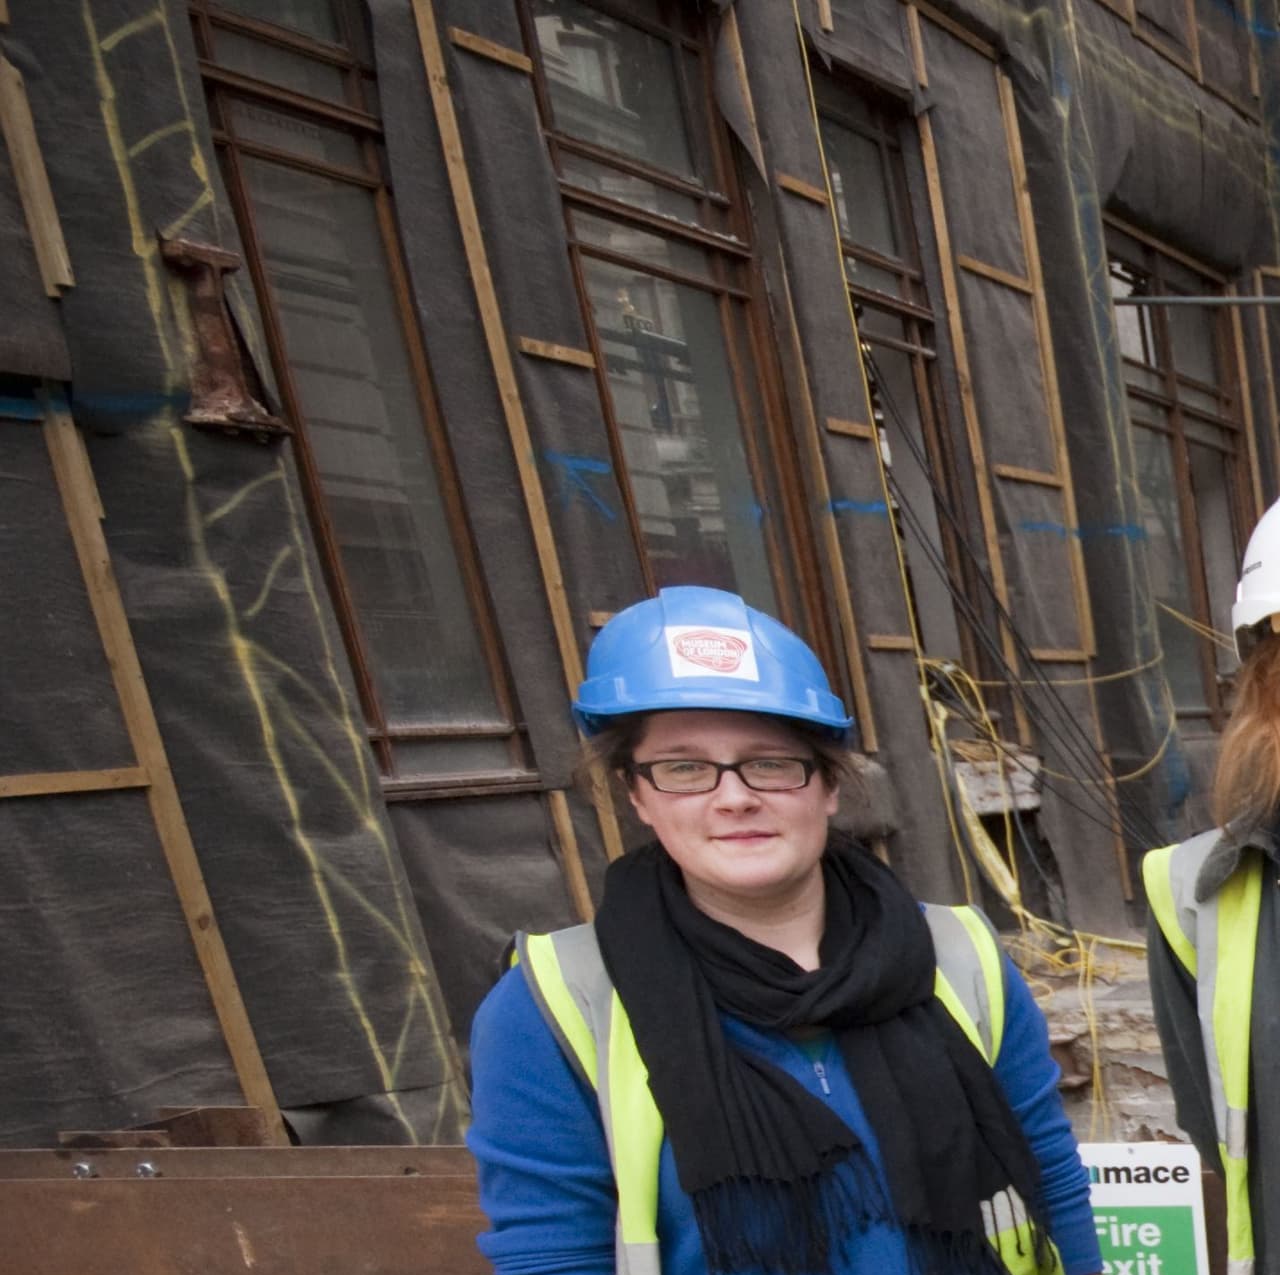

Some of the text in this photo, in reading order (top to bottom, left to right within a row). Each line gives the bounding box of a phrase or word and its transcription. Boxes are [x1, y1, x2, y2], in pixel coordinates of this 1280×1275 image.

[681, 639, 727, 650] MUSEUM
[683, 647, 739, 658] OF LONDON
[1103, 1165, 1190, 1184] mace
